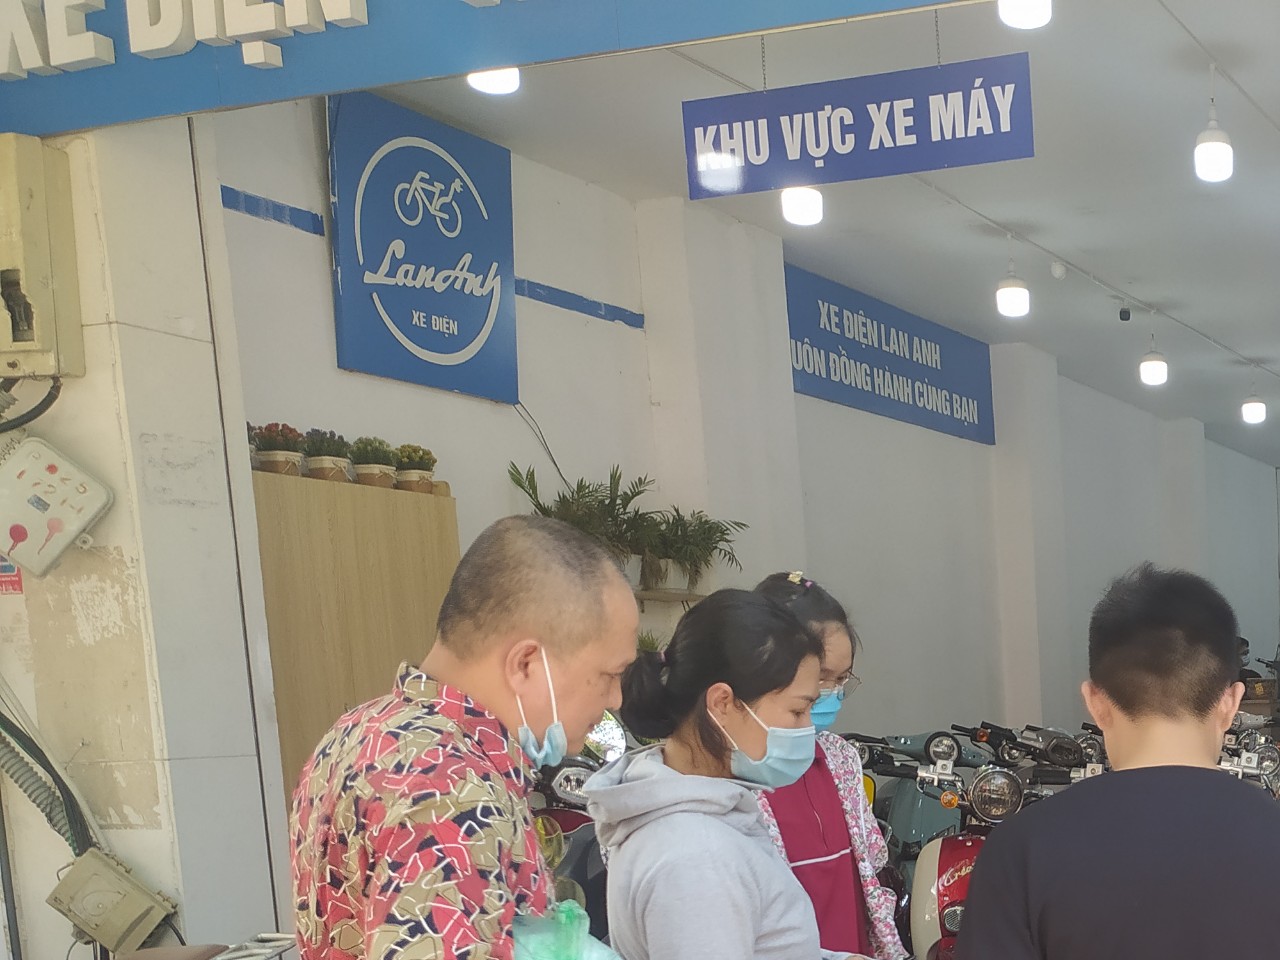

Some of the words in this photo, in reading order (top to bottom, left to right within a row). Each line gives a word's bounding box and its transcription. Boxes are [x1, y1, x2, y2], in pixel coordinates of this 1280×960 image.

[694, 118, 770, 171] KHU
[780, 105, 855, 168] VỰC
[866, 98, 917, 150] XE
[929, 78, 1016, 142] MÁY
[412, 310, 427, 328] XE
[431, 315, 458, 338] ĐIỆN
[817, 299, 840, 334] XE
[843, 310, 879, 348] ĐIỆN
[881, 323, 909, 359] LAN
[912, 336, 942, 370] ANH
[829, 345, 872, 392] ĐỒNG
[874, 366, 913, 405] HÀNH
[914, 378, 951, 416] CÙNG
[952, 393, 979, 426] BẠN
